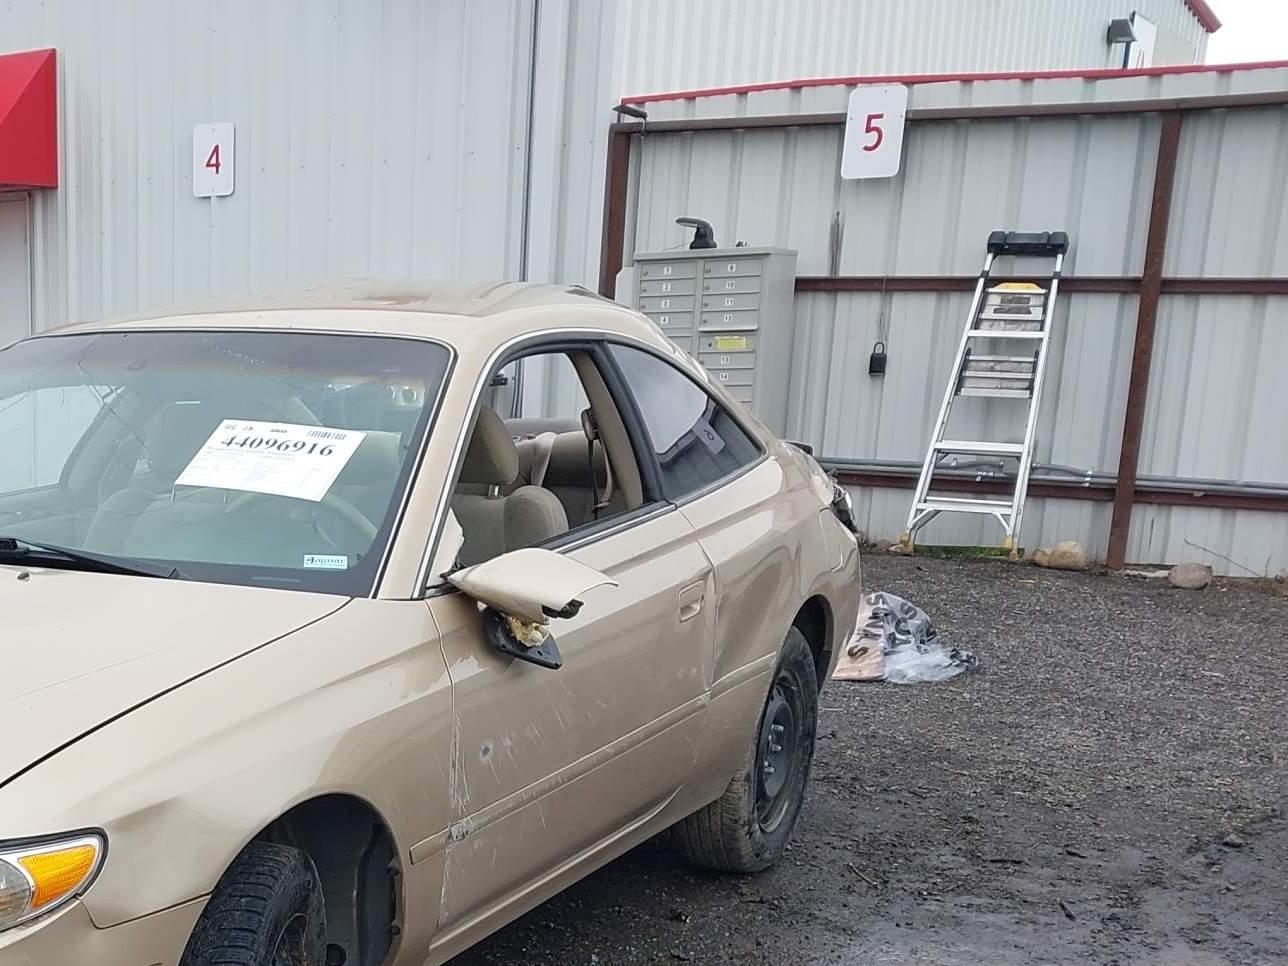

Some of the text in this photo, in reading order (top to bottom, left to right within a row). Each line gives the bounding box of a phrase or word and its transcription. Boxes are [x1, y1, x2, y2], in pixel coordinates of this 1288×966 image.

[862, 113, 884, 152] 5
[205, 144, 221, 174] 4
[220, 435, 335, 457] 44096916
